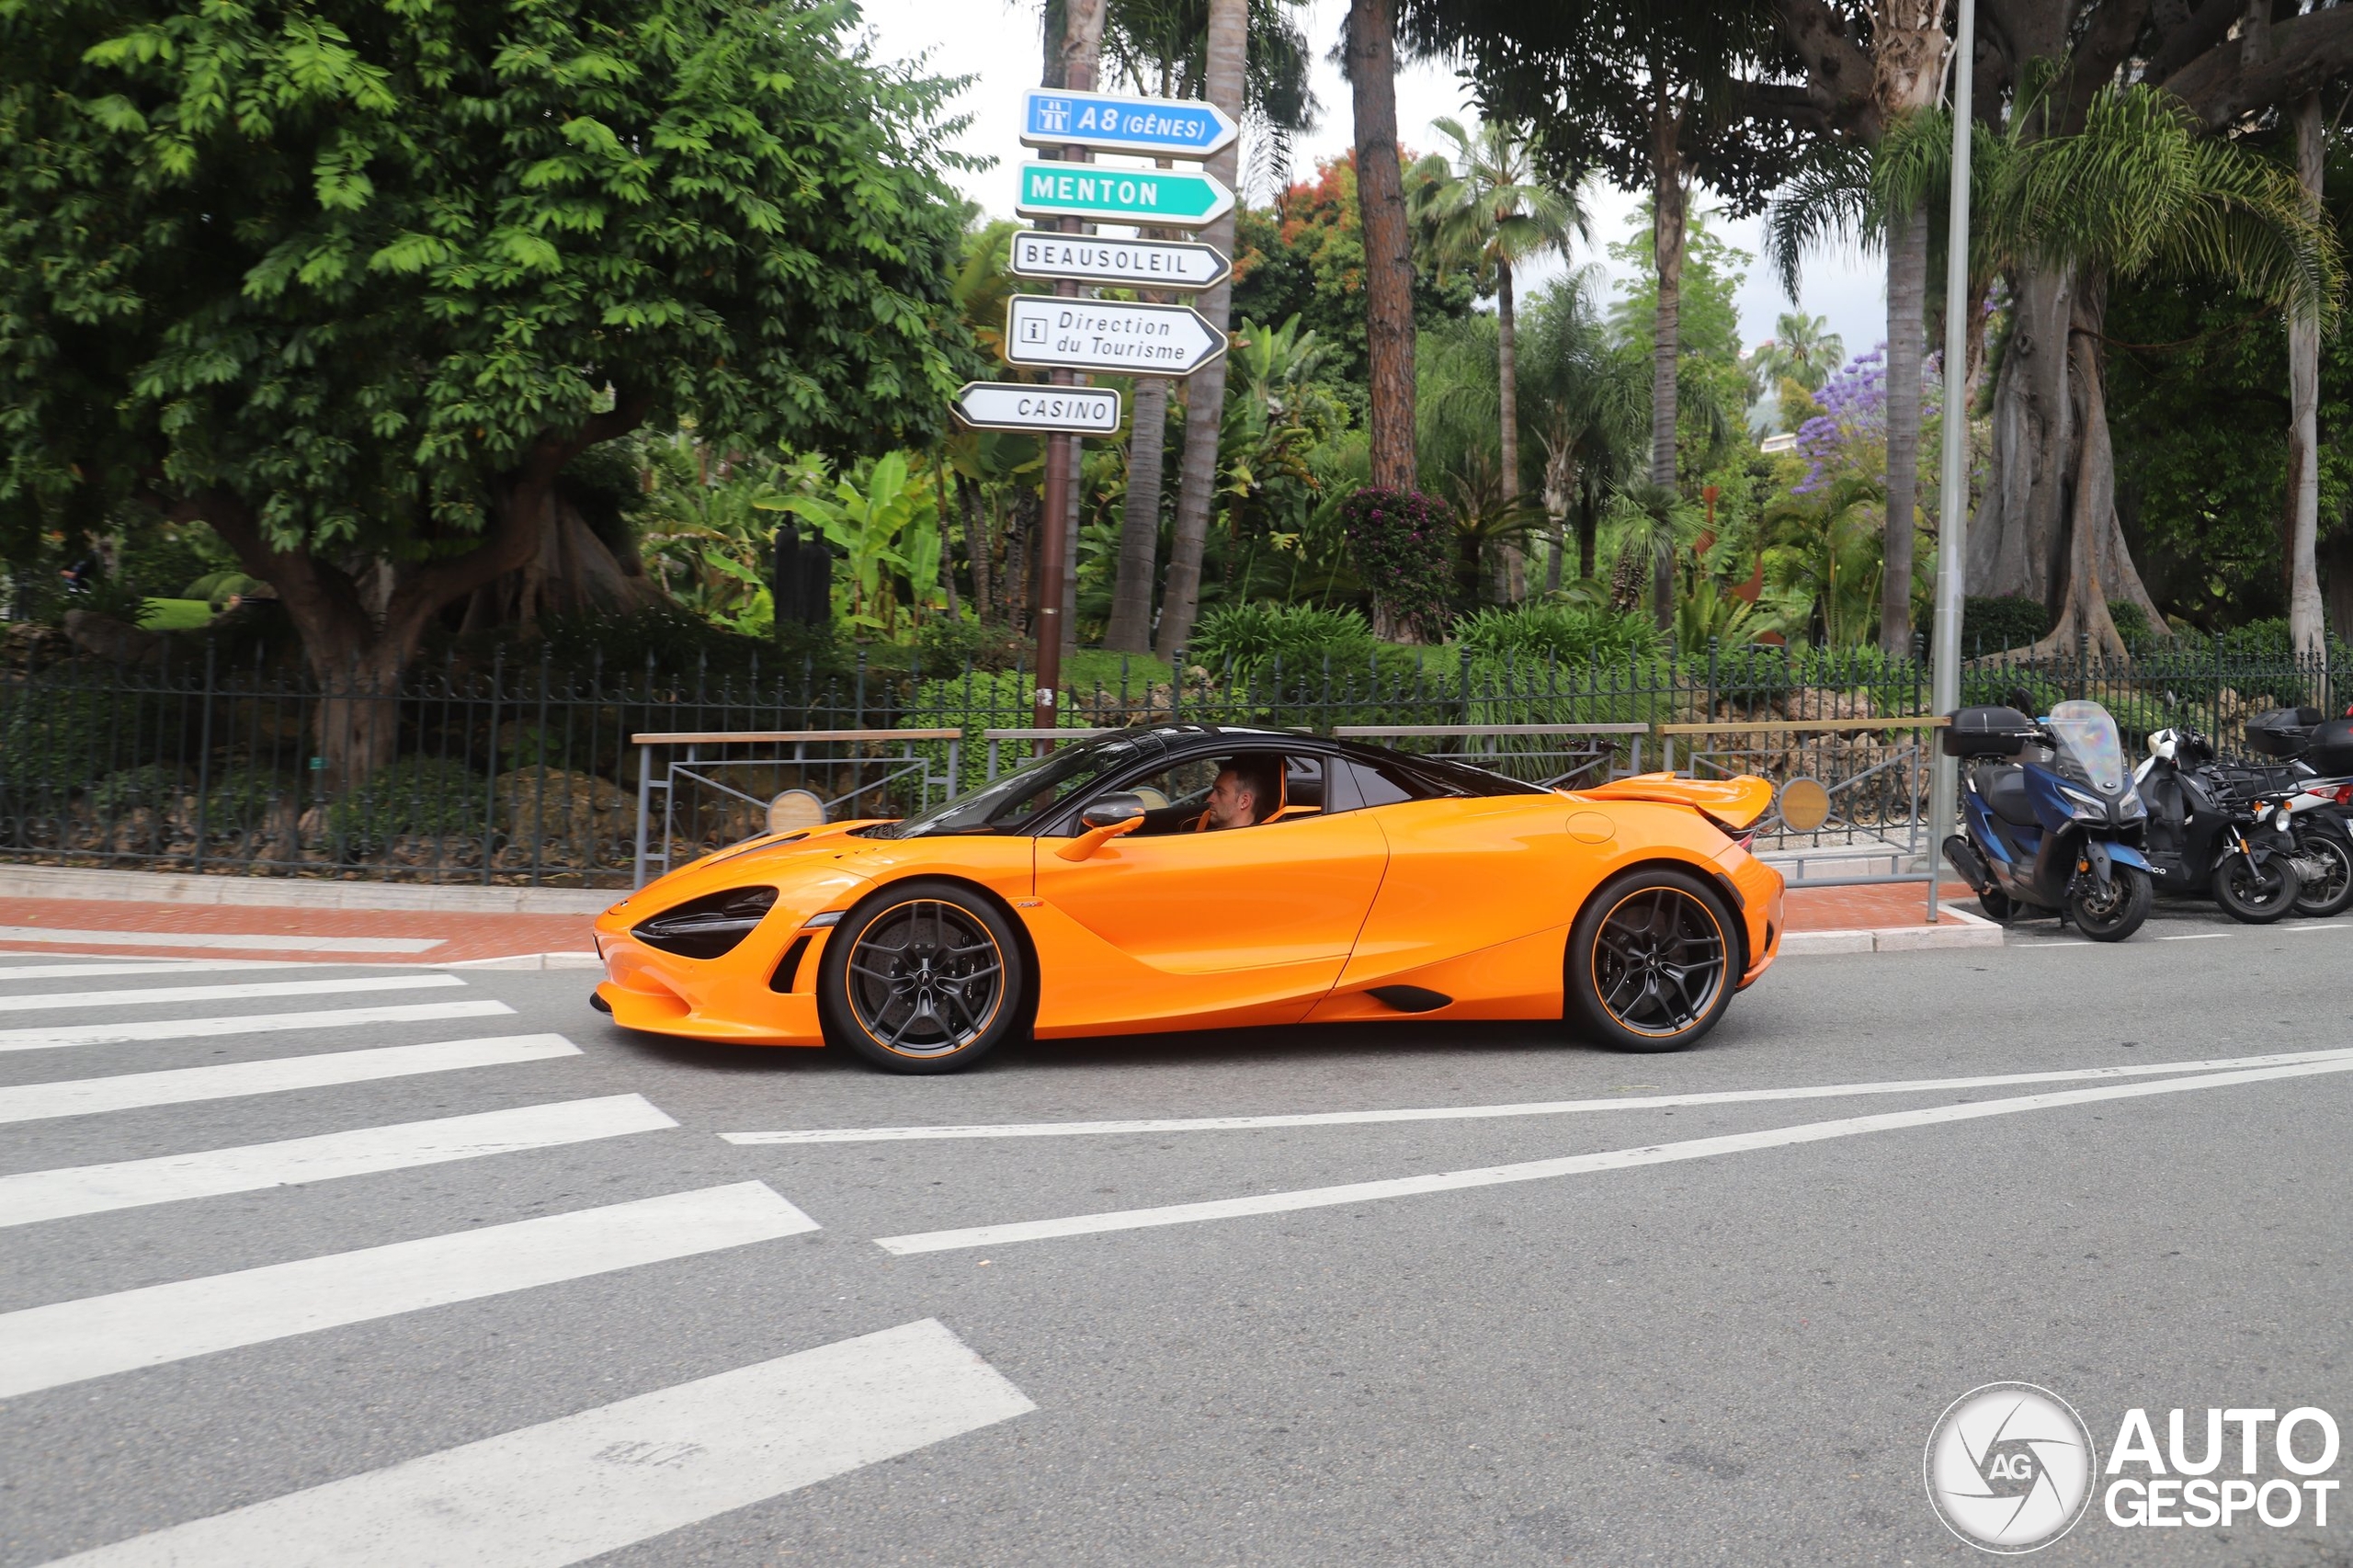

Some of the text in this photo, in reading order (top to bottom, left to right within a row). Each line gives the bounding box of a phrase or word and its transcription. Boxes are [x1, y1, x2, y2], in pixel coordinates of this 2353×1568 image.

[1122, 113, 1206, 140] (GÊNES)
[1030, 174, 1158, 206] MENTON
[1027, 244, 1187, 273] BEAUSOLEIL
[1059, 311, 1170, 336] Direction
[1057, 335, 1186, 360] du Tourisme
[1017, 398, 1107, 420] CASINO
